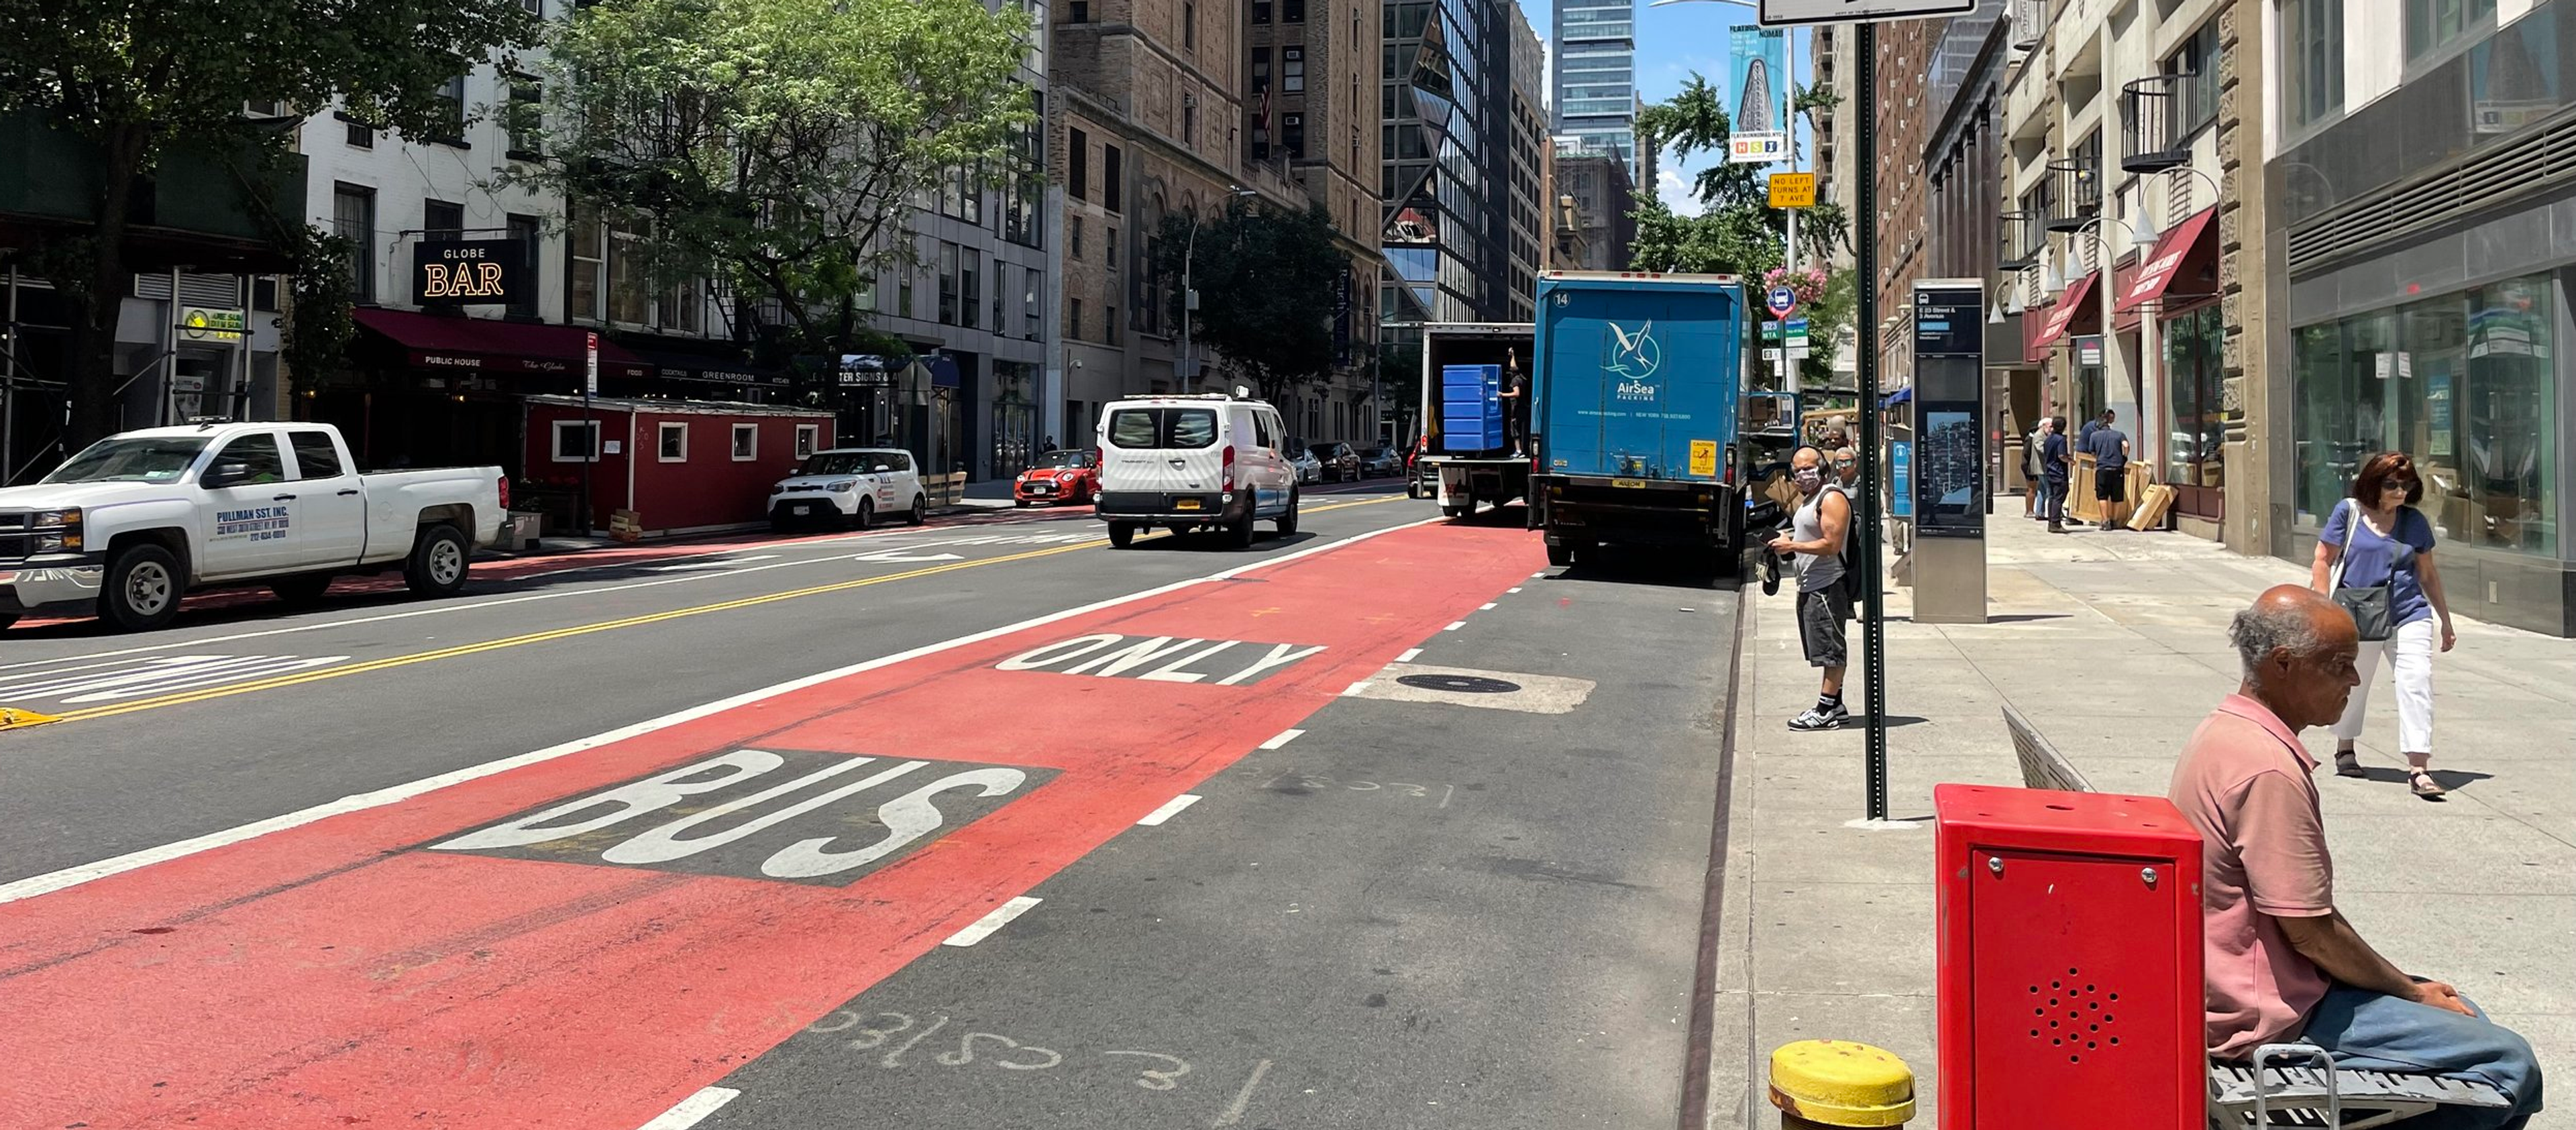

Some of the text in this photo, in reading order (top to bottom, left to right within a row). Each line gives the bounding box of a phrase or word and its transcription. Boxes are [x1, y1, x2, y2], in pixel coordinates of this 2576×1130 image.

[1759, 28, 1784, 38] NOMAD
[443, 248, 486, 259] GLOBE
[424, 262, 504, 296] BAR
[1555, 293, 1568, 305] 14
[425, 356, 481, 367] PUBLIC HOUSE
[702, 371, 754, 382] GREENROOM
[839, 373, 853, 382] TER
[856, 372, 881, 382] SIGNS
[883, 372, 889, 382] &
[1617, 382, 1654, 394] AirSea
[217, 510, 254, 522] PULLMAN
[995, 633, 1328, 685] ONLY
[429, 748, 1026, 878] BUS
